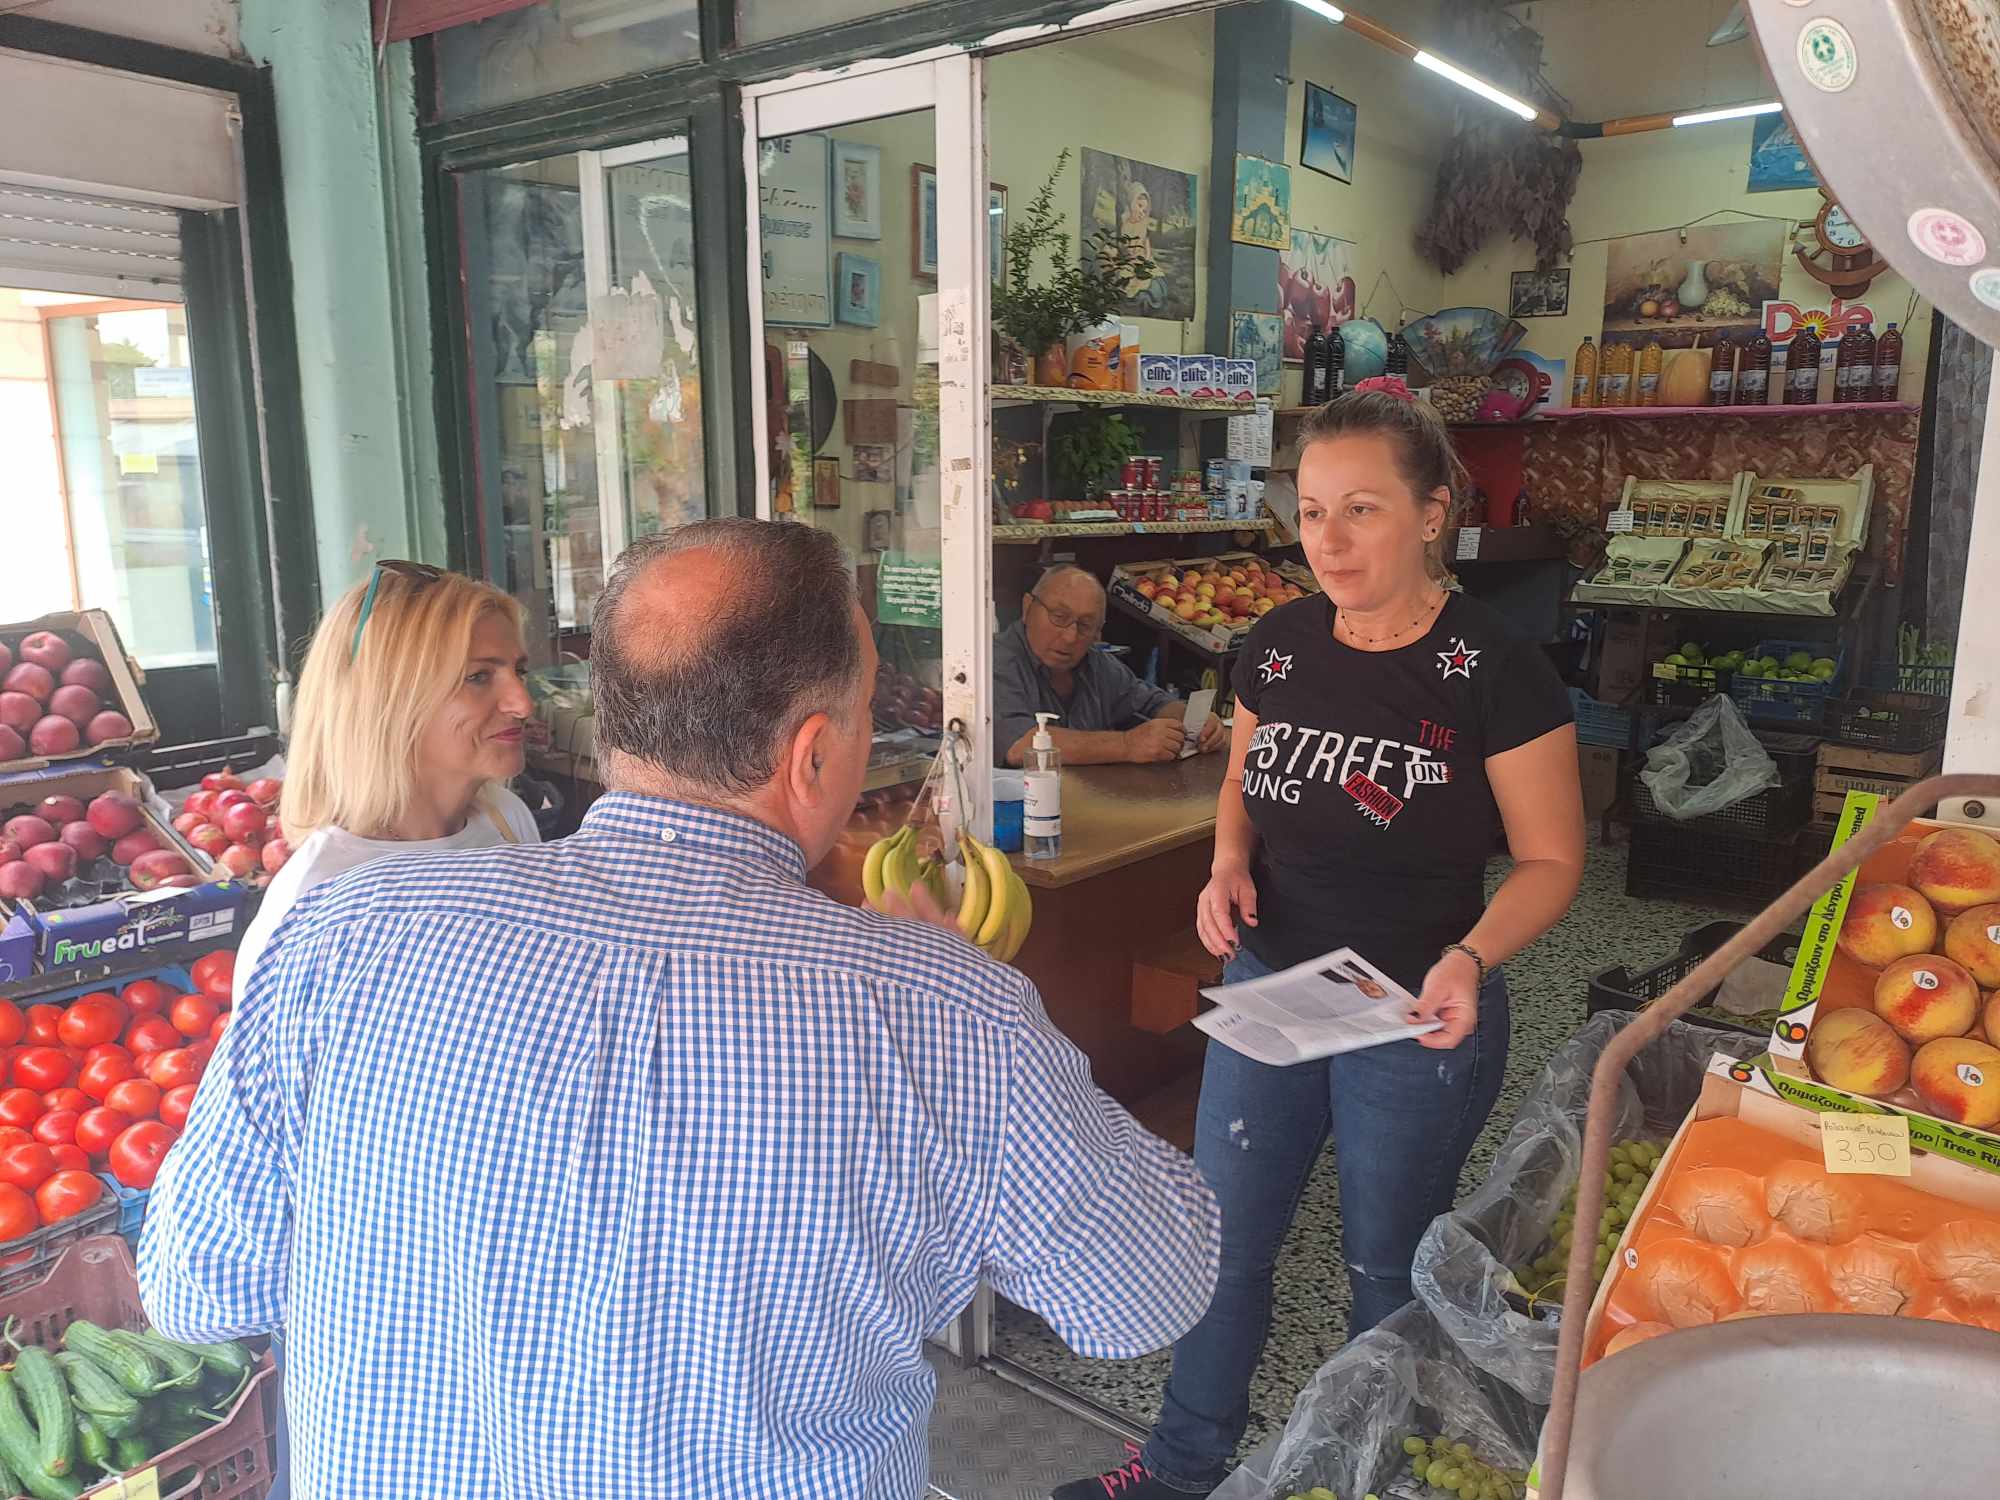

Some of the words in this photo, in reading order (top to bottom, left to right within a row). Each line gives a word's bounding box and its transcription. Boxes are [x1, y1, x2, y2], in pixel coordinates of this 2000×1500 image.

[1147, 366, 1172, 382] elite
[1181, 367, 1208, 382] elite
[1227, 372, 1249, 385] elite
[1420, 719, 1456, 749] THE
[1257, 722, 1431, 800] STREET
[1411, 763, 1444, 783] ON
[1347, 774, 1401, 819] FASHION
[1836, 1139, 1896, 1163] 3,50
[1942, 1137, 1977, 1157] Tree
